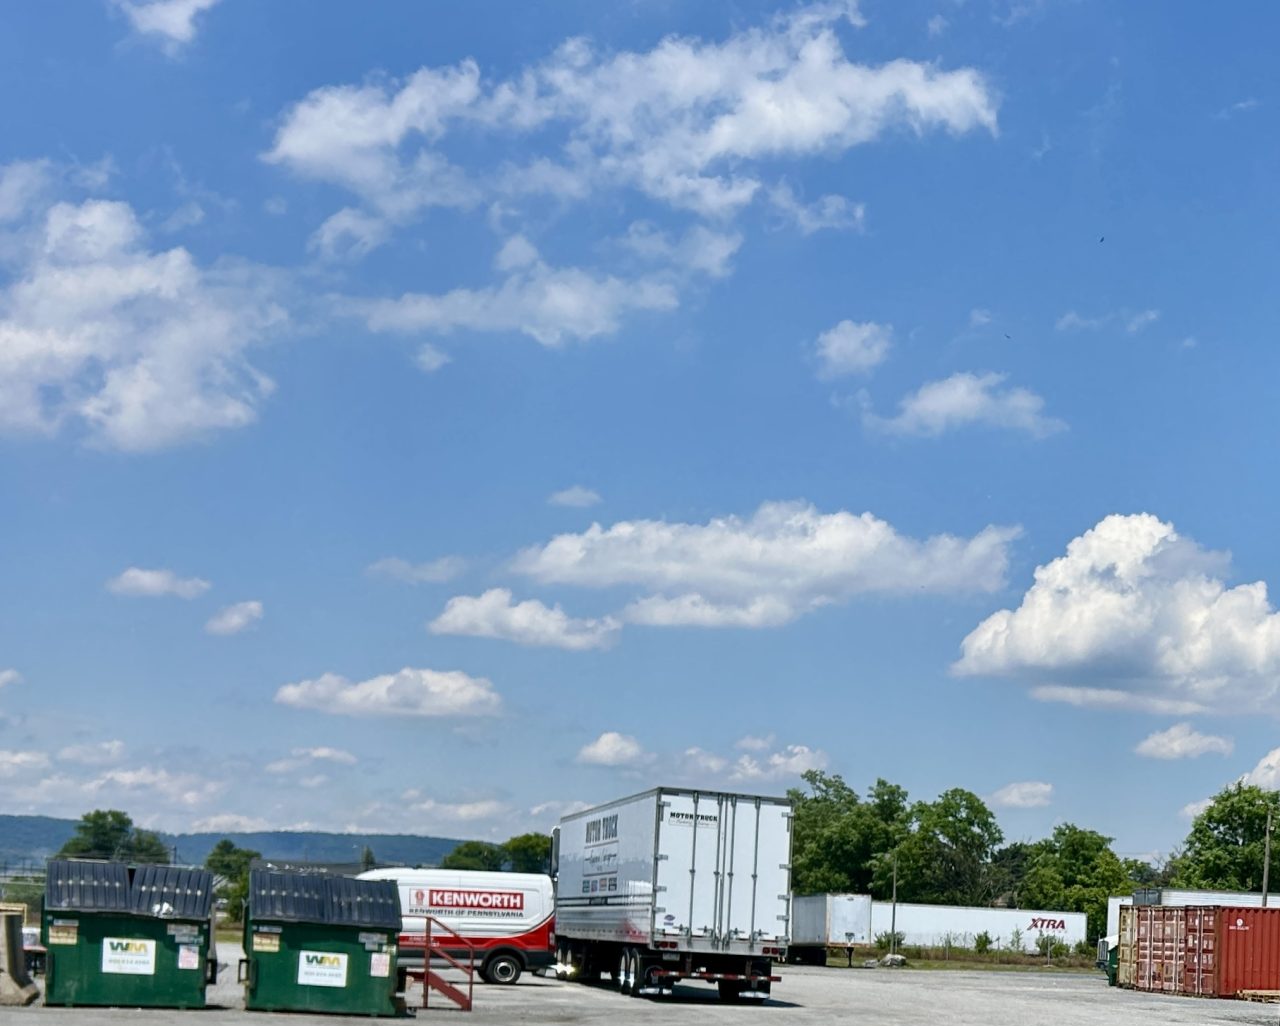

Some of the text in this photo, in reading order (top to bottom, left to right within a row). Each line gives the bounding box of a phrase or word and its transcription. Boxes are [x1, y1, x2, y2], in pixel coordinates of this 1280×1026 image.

[670, 811, 718, 822] MOTOR TRUCK
[432, 891, 521, 908] KENWORTH
[467, 910, 524, 918] PENNSYLVANIA
[1026, 917, 1066, 931] XTRA
[109, 941, 148, 953] WM
[305, 954, 341, 966] WM
